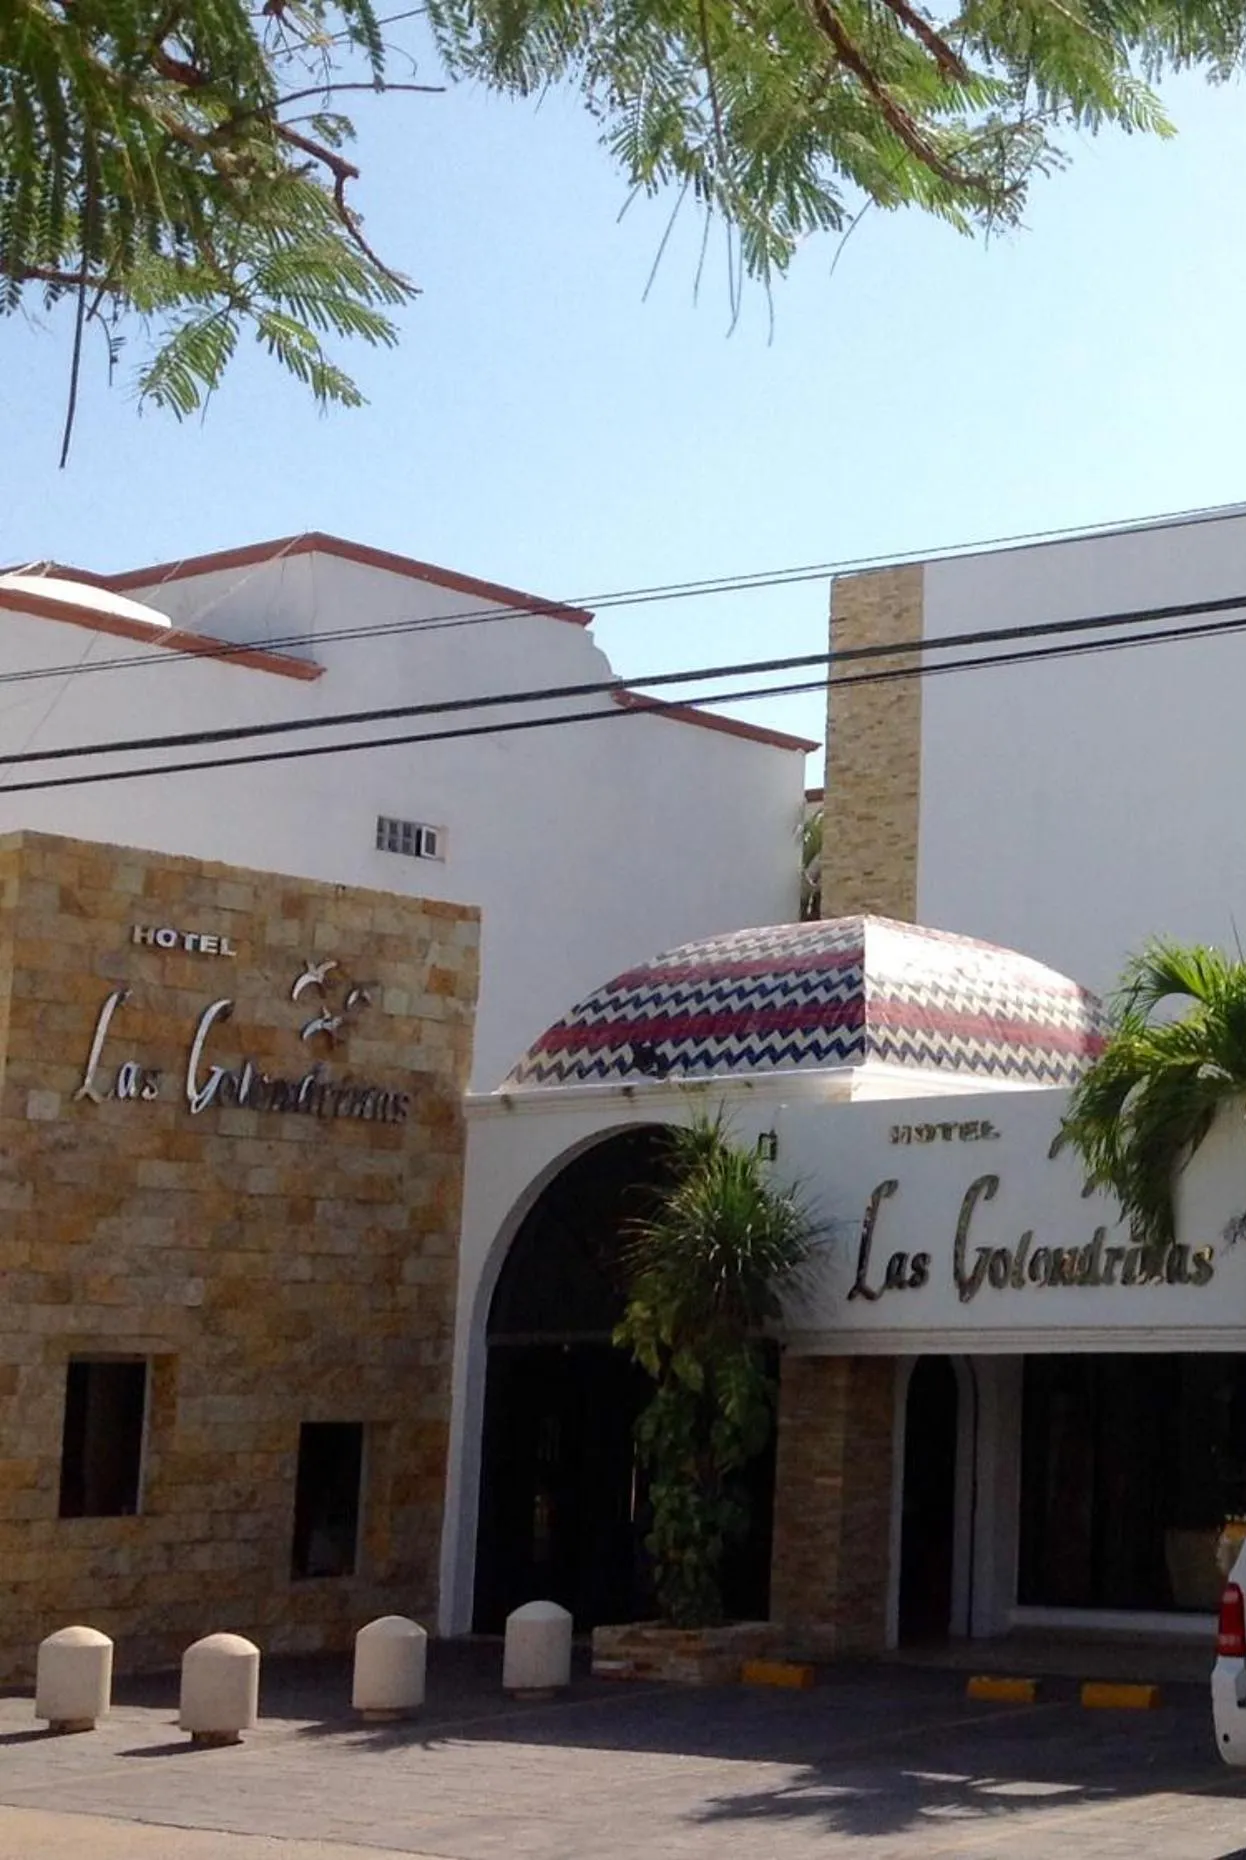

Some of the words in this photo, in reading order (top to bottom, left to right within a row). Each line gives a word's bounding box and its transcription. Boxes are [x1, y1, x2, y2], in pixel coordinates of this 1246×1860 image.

[132, 924, 237, 957] HOTEL
[72, 989, 162, 1104] Las
[889, 1120, 1002, 1145] HOTEL
[847, 1179, 932, 1303] Las
